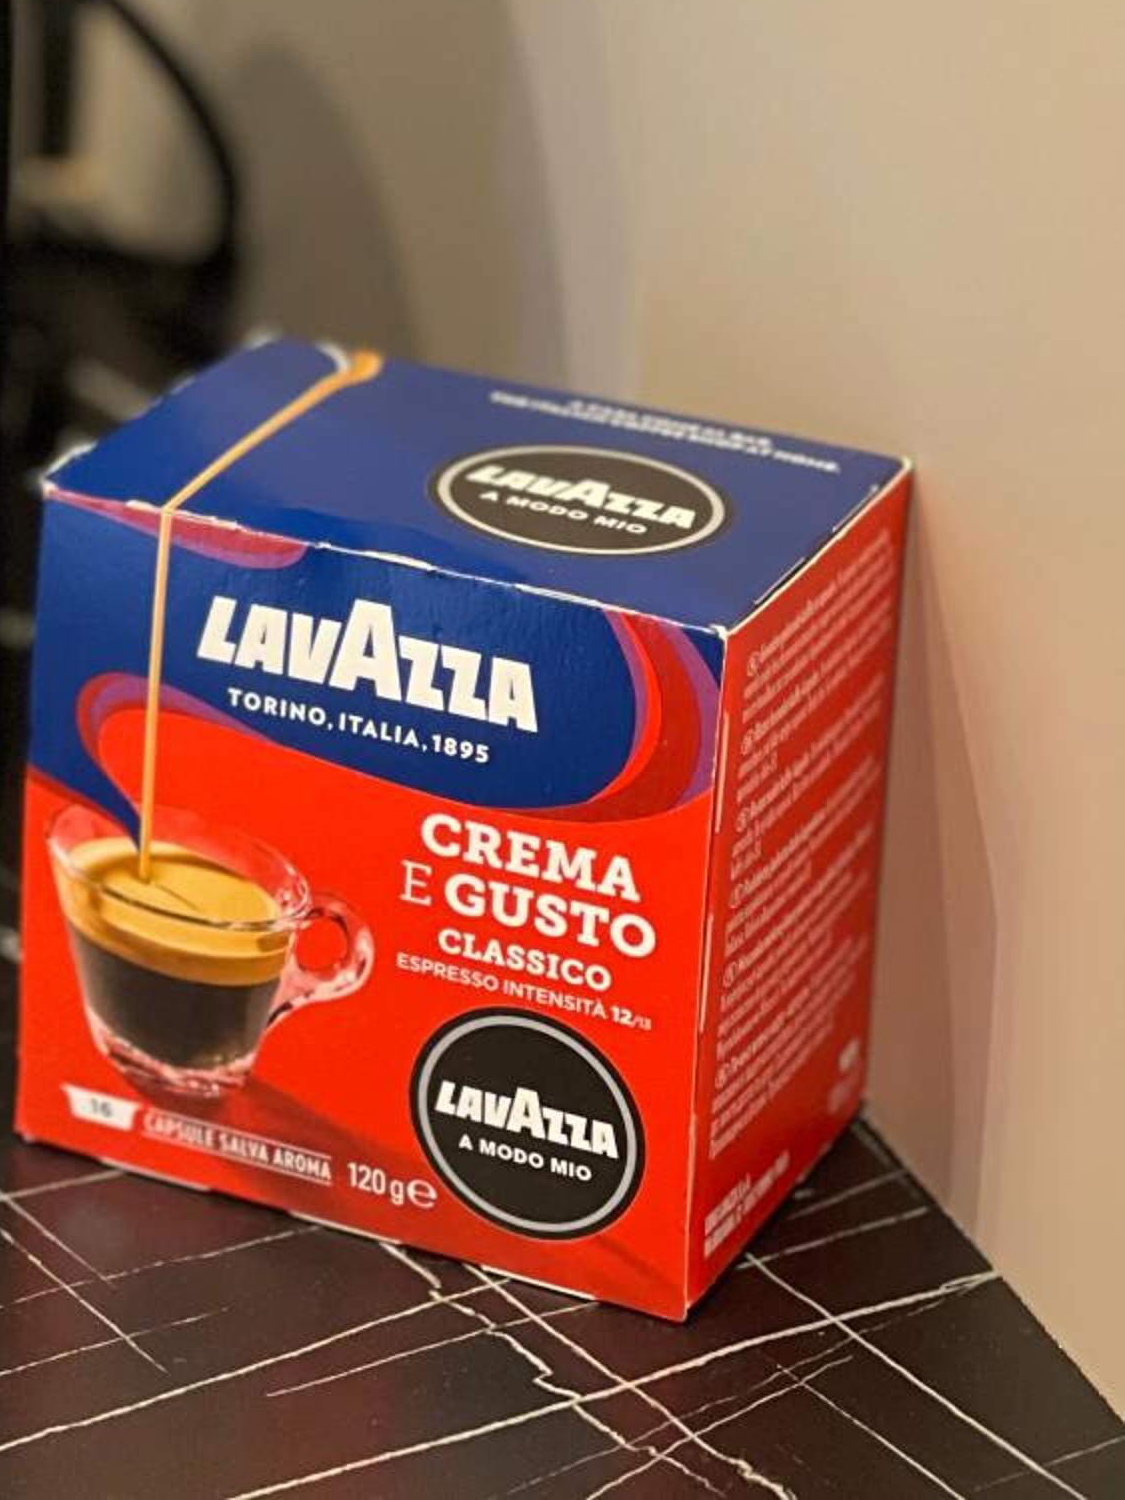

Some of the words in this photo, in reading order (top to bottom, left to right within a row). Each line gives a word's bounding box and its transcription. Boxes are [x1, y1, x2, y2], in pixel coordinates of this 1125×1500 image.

[465, 465, 696, 529] LAVAZZA
[479, 491, 500, 501] A
[506, 495, 588, 521] MODO
[594, 515, 648, 534] MIO
[196, 595, 539, 733] LAVAZZA
[228, 687, 333, 730] TORINO,
[432, 734, 490, 763] 1895
[421, 813, 642, 903] CREMA
[400, 859, 433, 906] E
[444, 873, 657, 958] GUSTO
[396, 952, 500, 992] ESPRESSO
[503, 980, 607, 1019] INTENSITÀ
[438, 928, 613, 991] CLASSICO
[143, 1112, 215, 1148] CAPSULE
[219, 1132, 269, 1162] SALVA
[274, 1148, 332, 1180] AROMA
[434, 1079, 620, 1159] LAVAZZA
[458, 1134, 473, 1150] A
[479, 1139, 544, 1169] MODO
[550, 1157, 592, 1181] MIO
